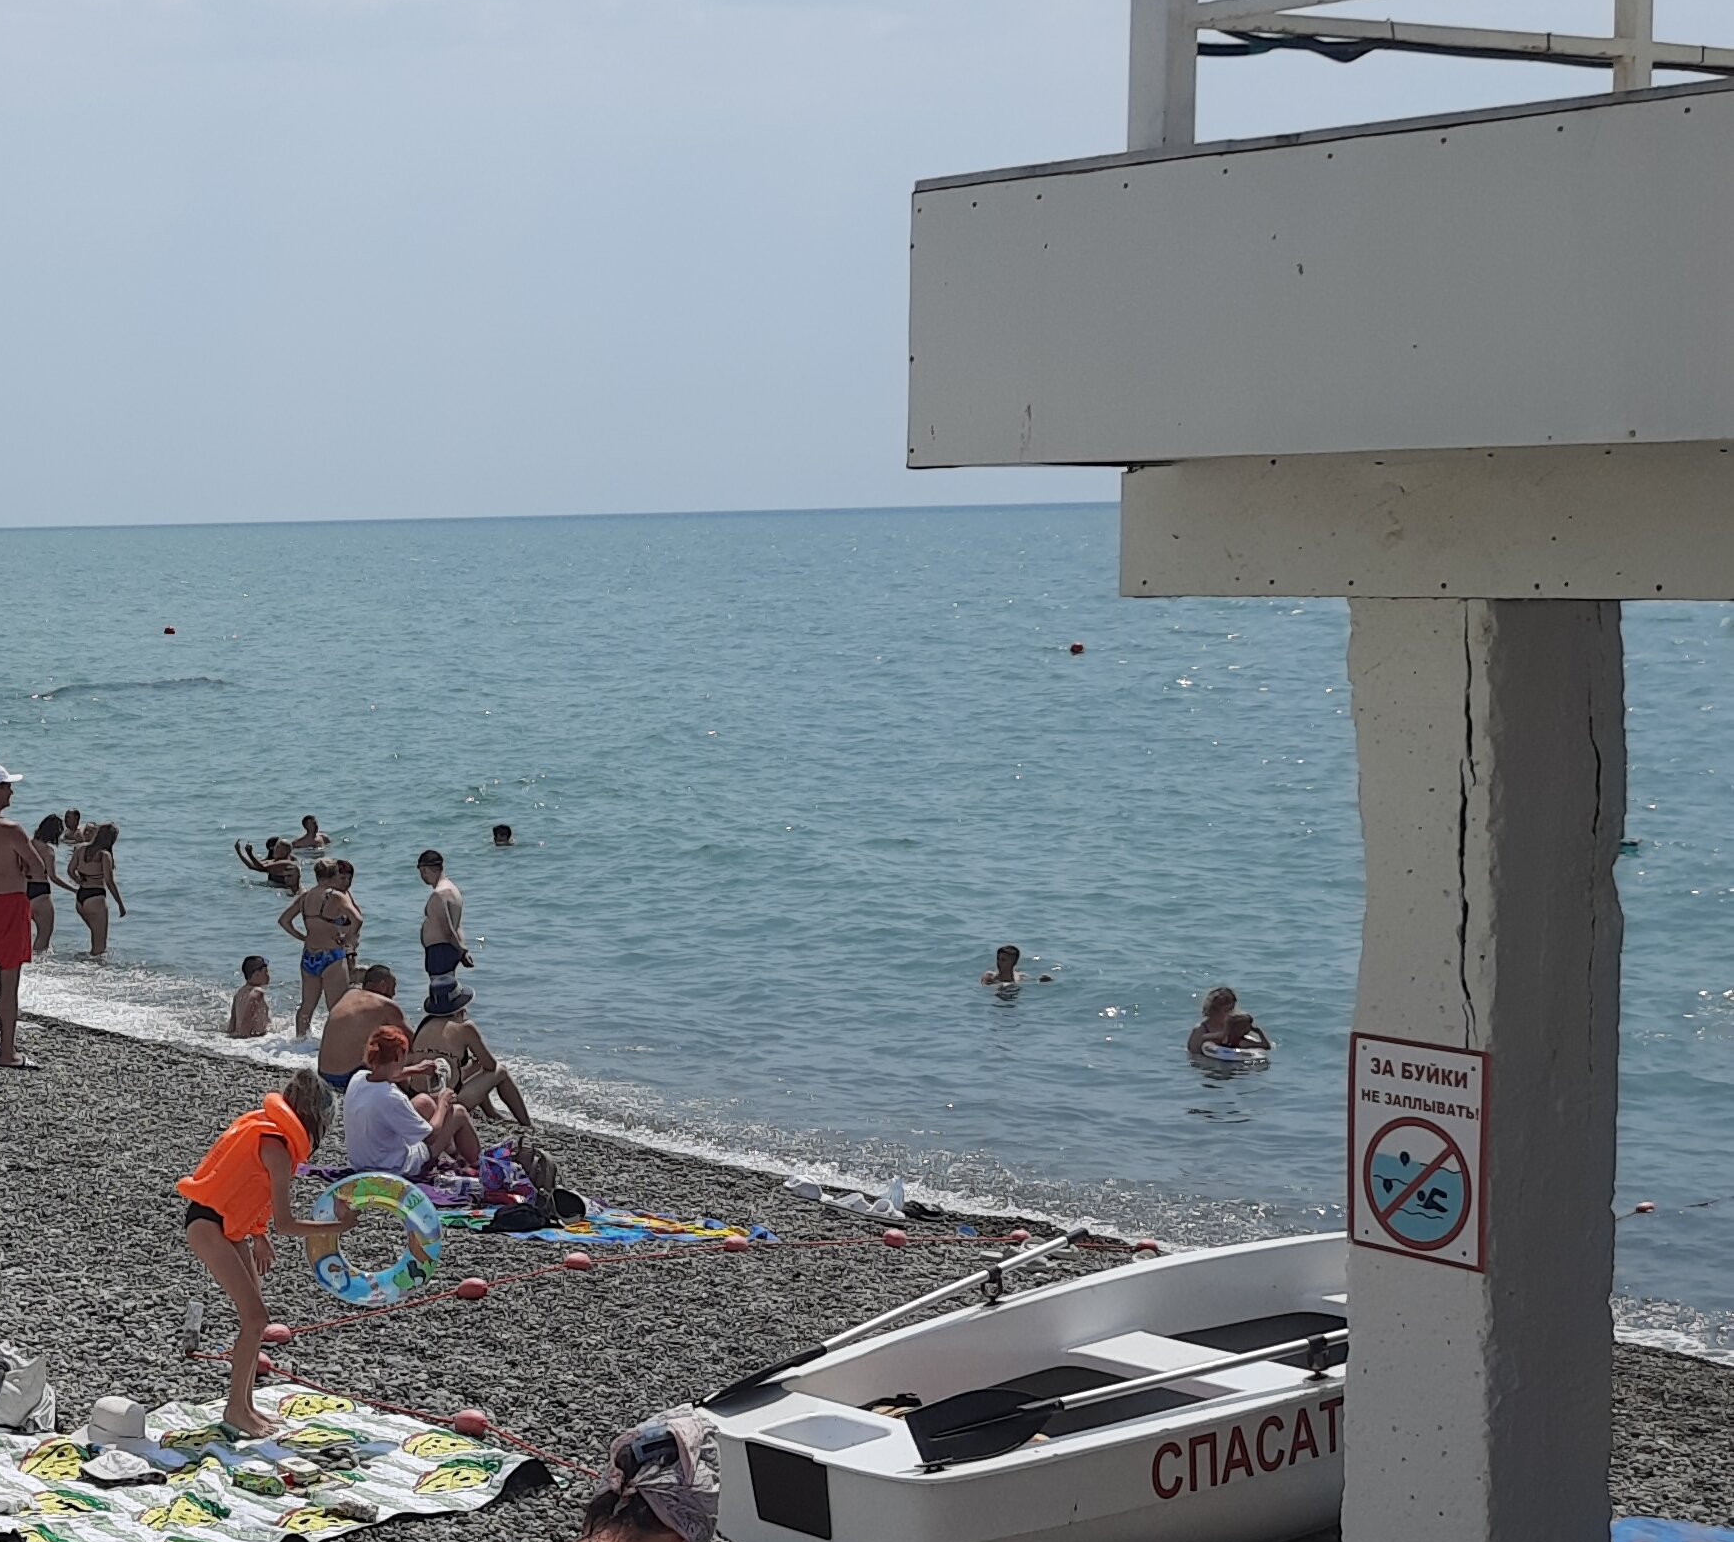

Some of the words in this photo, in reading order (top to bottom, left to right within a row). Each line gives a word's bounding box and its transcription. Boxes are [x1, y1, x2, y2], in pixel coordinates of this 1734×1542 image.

[1370, 1057, 1395, 1078] ЗА
[1401, 1061, 1468, 1089] БУЙКИ
[1361, 1088, 1382, 1104] НЕ
[1384, 1092, 1479, 1121] ЗАПЛЫВАТЬ!
